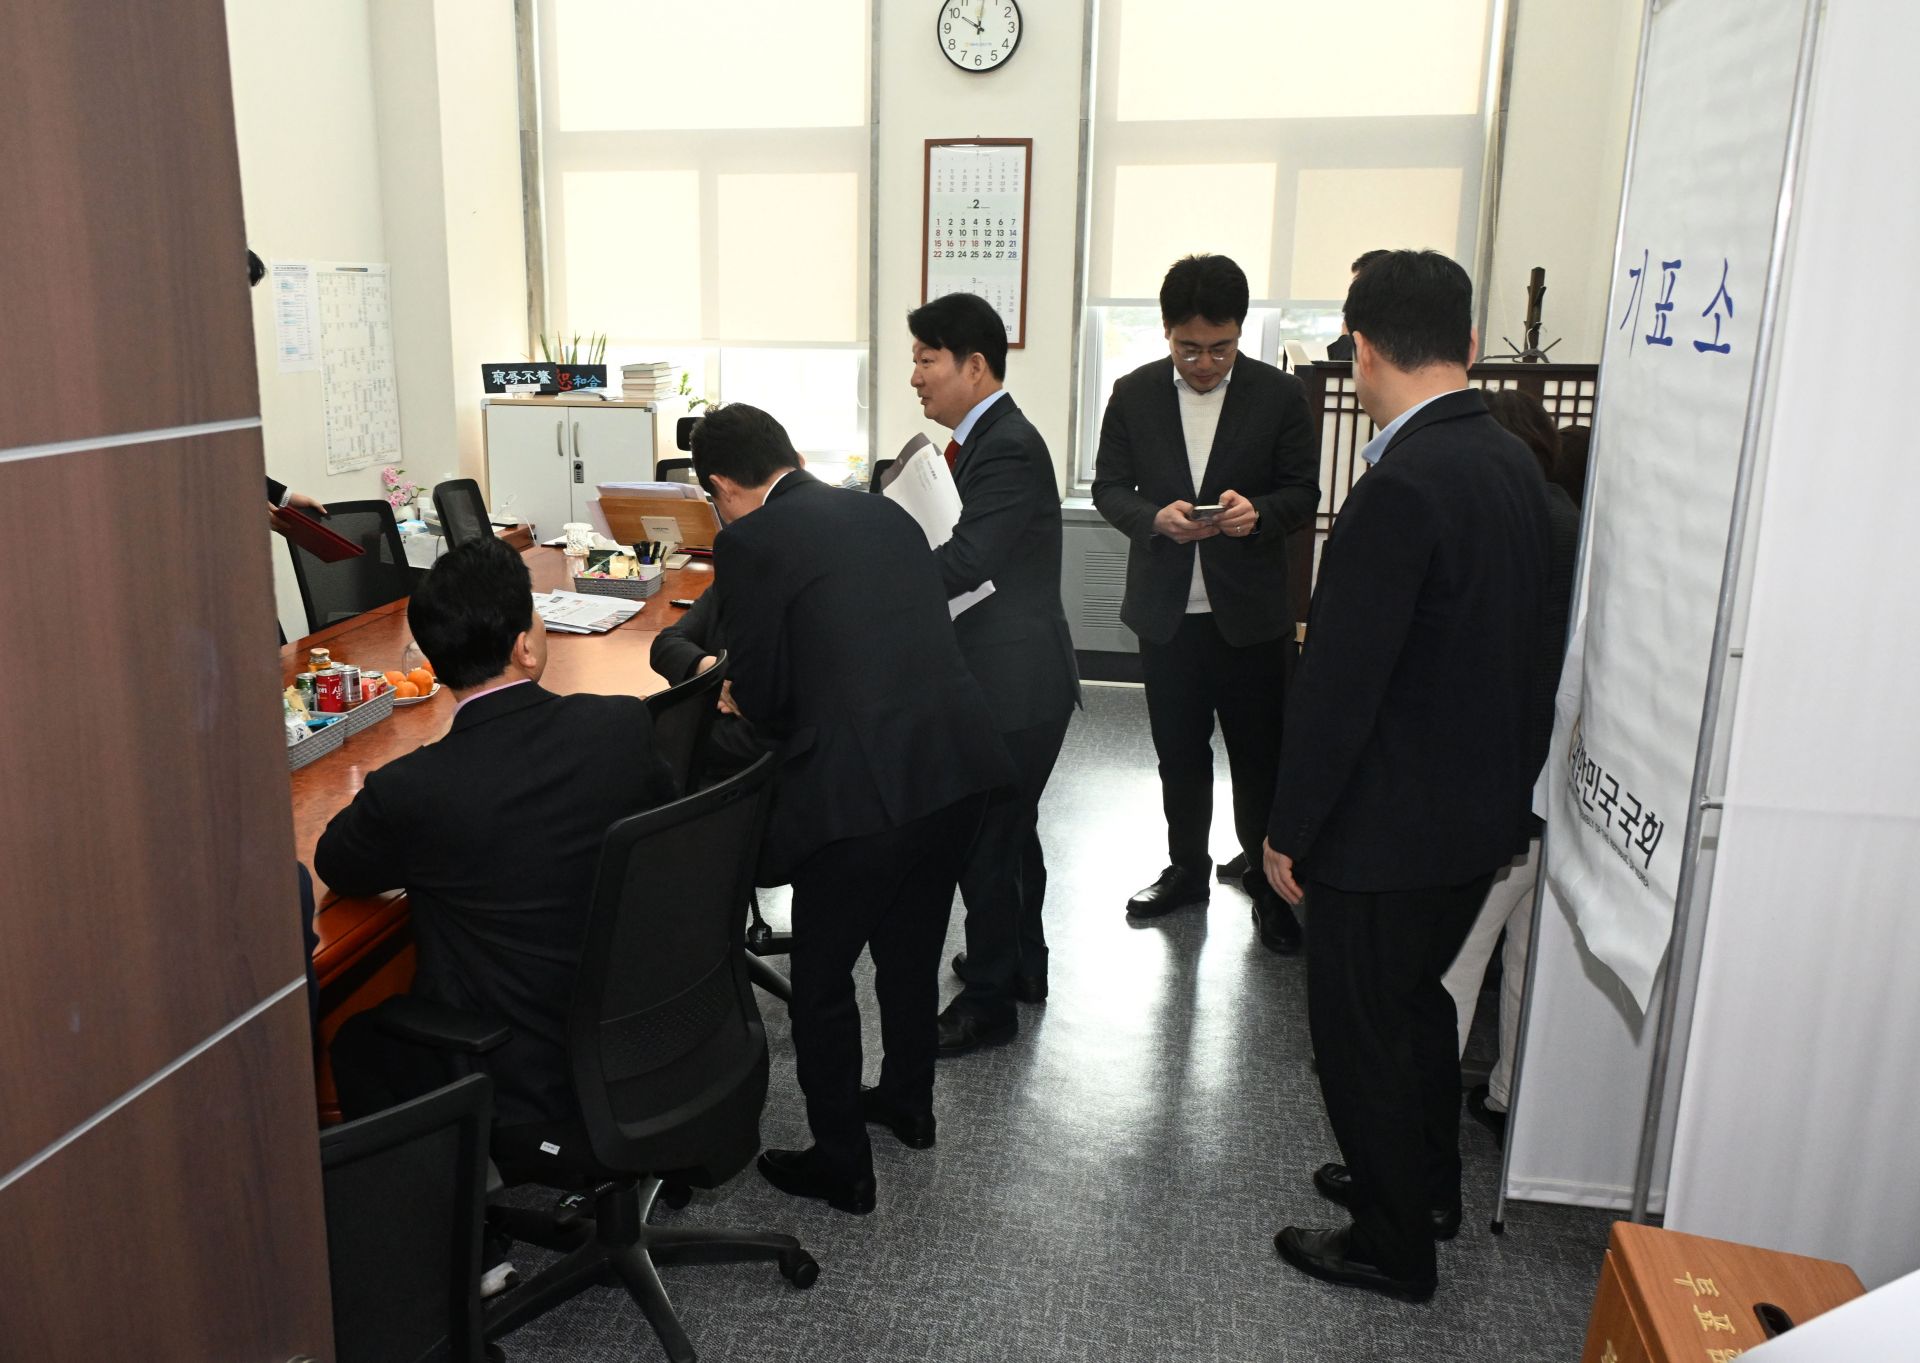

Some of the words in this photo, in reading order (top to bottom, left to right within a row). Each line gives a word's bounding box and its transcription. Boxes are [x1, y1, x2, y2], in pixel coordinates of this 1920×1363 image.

[948, 7, 960, 18] 10
[1004, 7, 1012, 18] 2
[943, 22, 951, 34] 9
[1007, 22, 1015, 33] 3
[948, 38, 956, 50] 8
[1001, 38, 1009, 49] 4
[961, 50, 967, 61] 7
[974, 54, 982, 66] 6
[990, 49, 998, 61] 5
[972, 199, 980, 209] 2
[1619, 248, 1734, 360] 기표소
